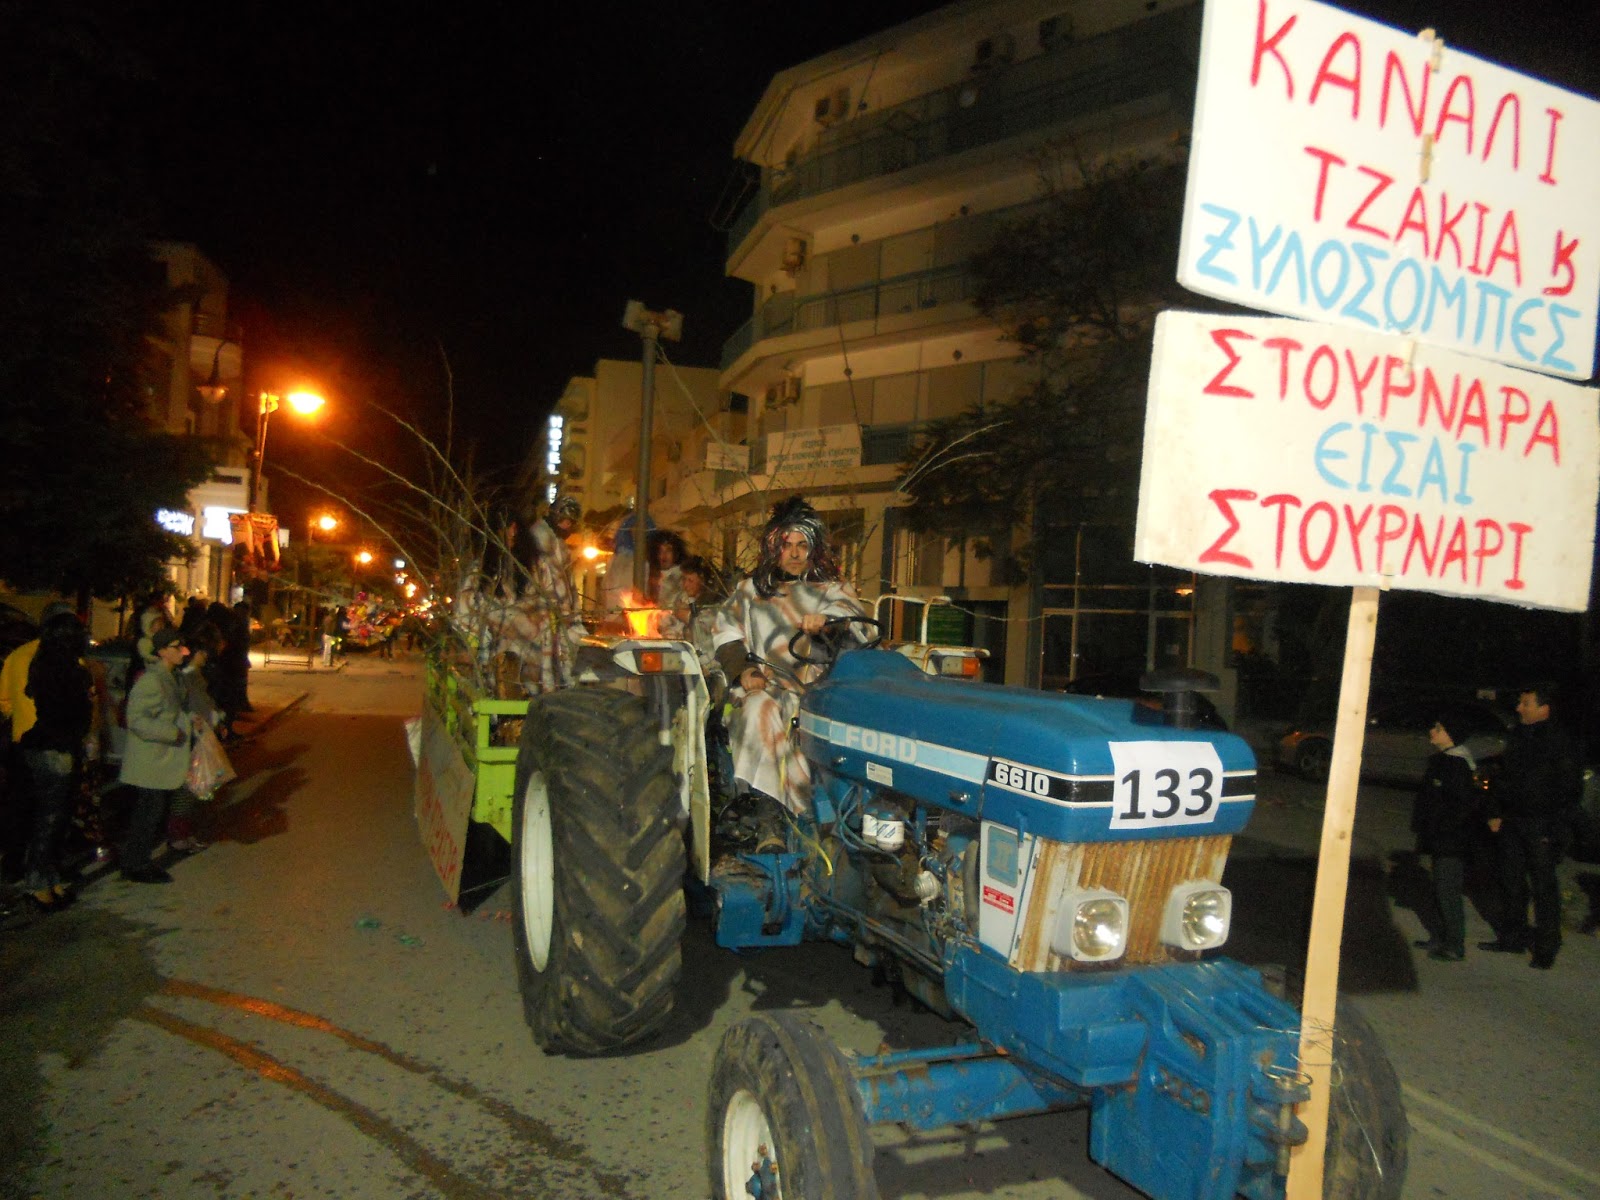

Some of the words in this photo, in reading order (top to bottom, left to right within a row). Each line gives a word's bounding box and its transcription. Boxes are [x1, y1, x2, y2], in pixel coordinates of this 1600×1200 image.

[1250, 0, 1563, 186] ΚΑΝΑΛΙ
[1303, 146, 1522, 287] ΤΖΑΚΙΑ
[1202, 328, 1561, 466] ΣΤΟΥΡΝΑΡΑ
[1314, 421, 1477, 505] ΕΙΣΑΙ
[1198, 488, 1534, 590] ΣΤΟΥΡΝΑΡΙ
[845, 725, 917, 763] FORD
[995, 763, 1050, 796] 6610
[1120, 767, 1213, 820] 133
